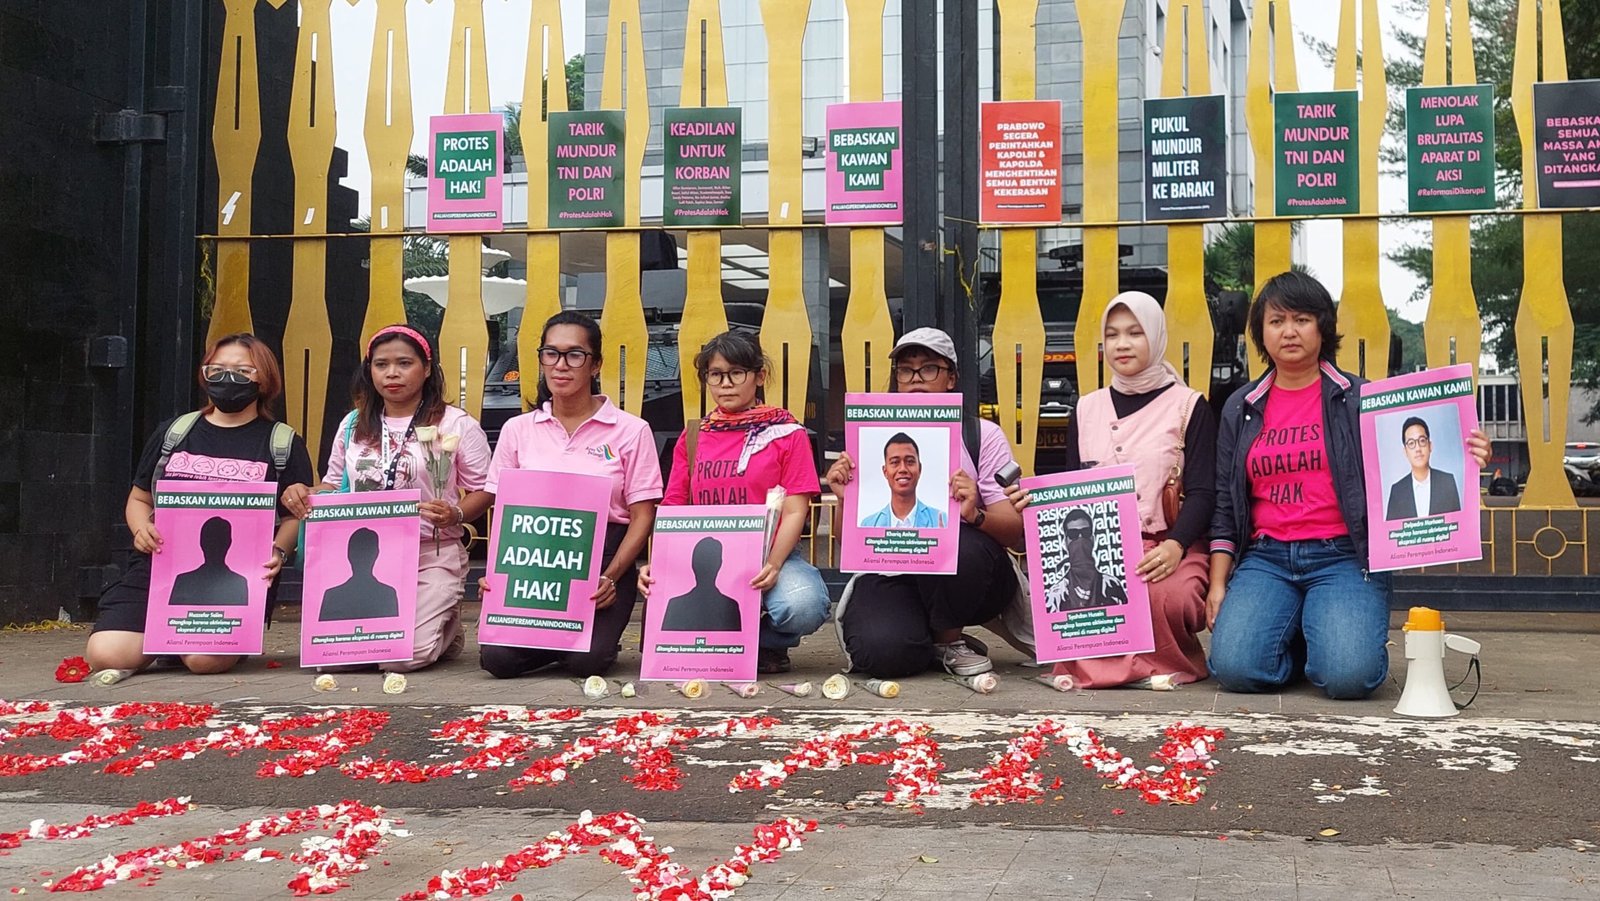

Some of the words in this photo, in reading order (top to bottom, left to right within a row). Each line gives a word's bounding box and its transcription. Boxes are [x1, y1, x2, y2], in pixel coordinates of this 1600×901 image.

[1420, 95, 1478, 109] MENOLAK
[1297, 104, 1337, 118] TARIK
[996, 122, 1046, 131] PRABOWO
[1151, 116, 1190, 134] PUKUL
[1436, 114, 1464, 126] LUPA
[569, 122, 605, 136] TARIK
[670, 122, 735, 136] KEADILAN
[1003, 132, 1039, 140] SEGERA
[1284, 127, 1349, 142] MUNDUR
[1558, 128, 1599, 138] SEMUA
[444, 137, 489, 151] PROTES
[834, 131, 895, 147] BEBASKAN
[1417, 131, 1483, 145] BRUTALITAS
[556, 144, 616, 158] MUNDUR
[680, 144, 726, 158] UNTUK
[989, 141, 1054, 150] PERINTAHKAN
[1151, 138, 1202, 156] MUNDUR
[1543, 141, 1584, 151] MASSA
[841, 152, 888, 167] KAWAN
[996, 151, 1037, 159] KAPOLRI
[1038, 150, 1046, 158] &
[1284, 151, 1308, 165] TNI
[1313, 150, 1345, 164] DAN
[1421, 151, 1464, 163] APARAT
[1467, 150, 1480, 161] DI
[1563, 152, 1596, 162] YANG
[439, 159, 492, 172] ADALAH
[999, 160, 1043, 168] KAPOLDA
[1152, 160, 1199, 178] MILITER
[557, 166, 579, 180] TNI
[583, 166, 612, 179] DAN
[675, 166, 730, 179] KORBAN
[985, 169, 1058, 178] MENGHENTIKAN
[1297, 172, 1337, 187] POLRI
[1436, 169, 1462, 181] AKSI
[451, 180, 481, 193] HAK!
[849, 173, 880, 187] KAMI
[986, 179, 1018, 187] SEMUA
[1020, 178, 1056, 187] BENTUK
[569, 187, 604, 201] POLRI
[994, 188, 1048, 196] KEKERASAN
[1152, 183, 1168, 199] KE
[1170, 181, 1215, 198] BARAK!
[1417, 186, 1486, 196] #ReformasiDikorupsi
[1287, 197, 1347, 206] #ProtesAdalahHak
[674, 208, 729, 216] #ProtesAdalahHak
[1361, 392, 1404, 410] BEBASKAN
[1406, 386, 1441, 402] KAWAN
[1443, 380, 1472, 396] KAMI!
[847, 408, 894, 418] BEBASKAN
[896, 408, 931, 418] KAWAN
[933, 408, 960, 419] KAMI!
[1256, 424, 1320, 448] PROTES
[1251, 449, 1321, 479] ADALAH
[1070, 483, 1104, 499] KAWAN
[1107, 478, 1133, 492] KAMI!
[1270, 482, 1304, 505] HAK
[157, 495, 206, 505] BEBASKAN
[208, 496, 244, 506] KAWAN
[247, 497, 274, 507] KAMI!
[356, 505, 391, 516] KAWAN
[511, 514, 583, 538] PROTES
[656, 520, 701, 529] BEBASKAN
[702, 519, 736, 528] KAWAN
[738, 518, 764, 528] KAMI!
[1434, 546, 1458, 554] Indonesia
[501, 546, 584, 571] ADALAH
[881, 558, 910, 566] Perempuan
[513, 579, 562, 602] HAK!
[488, 615, 582, 630] #ALIANSIPEREMPUANINDONESIA
[1074, 642, 1102, 650] Perempuan
[680, 666, 709, 674] Perempuan
